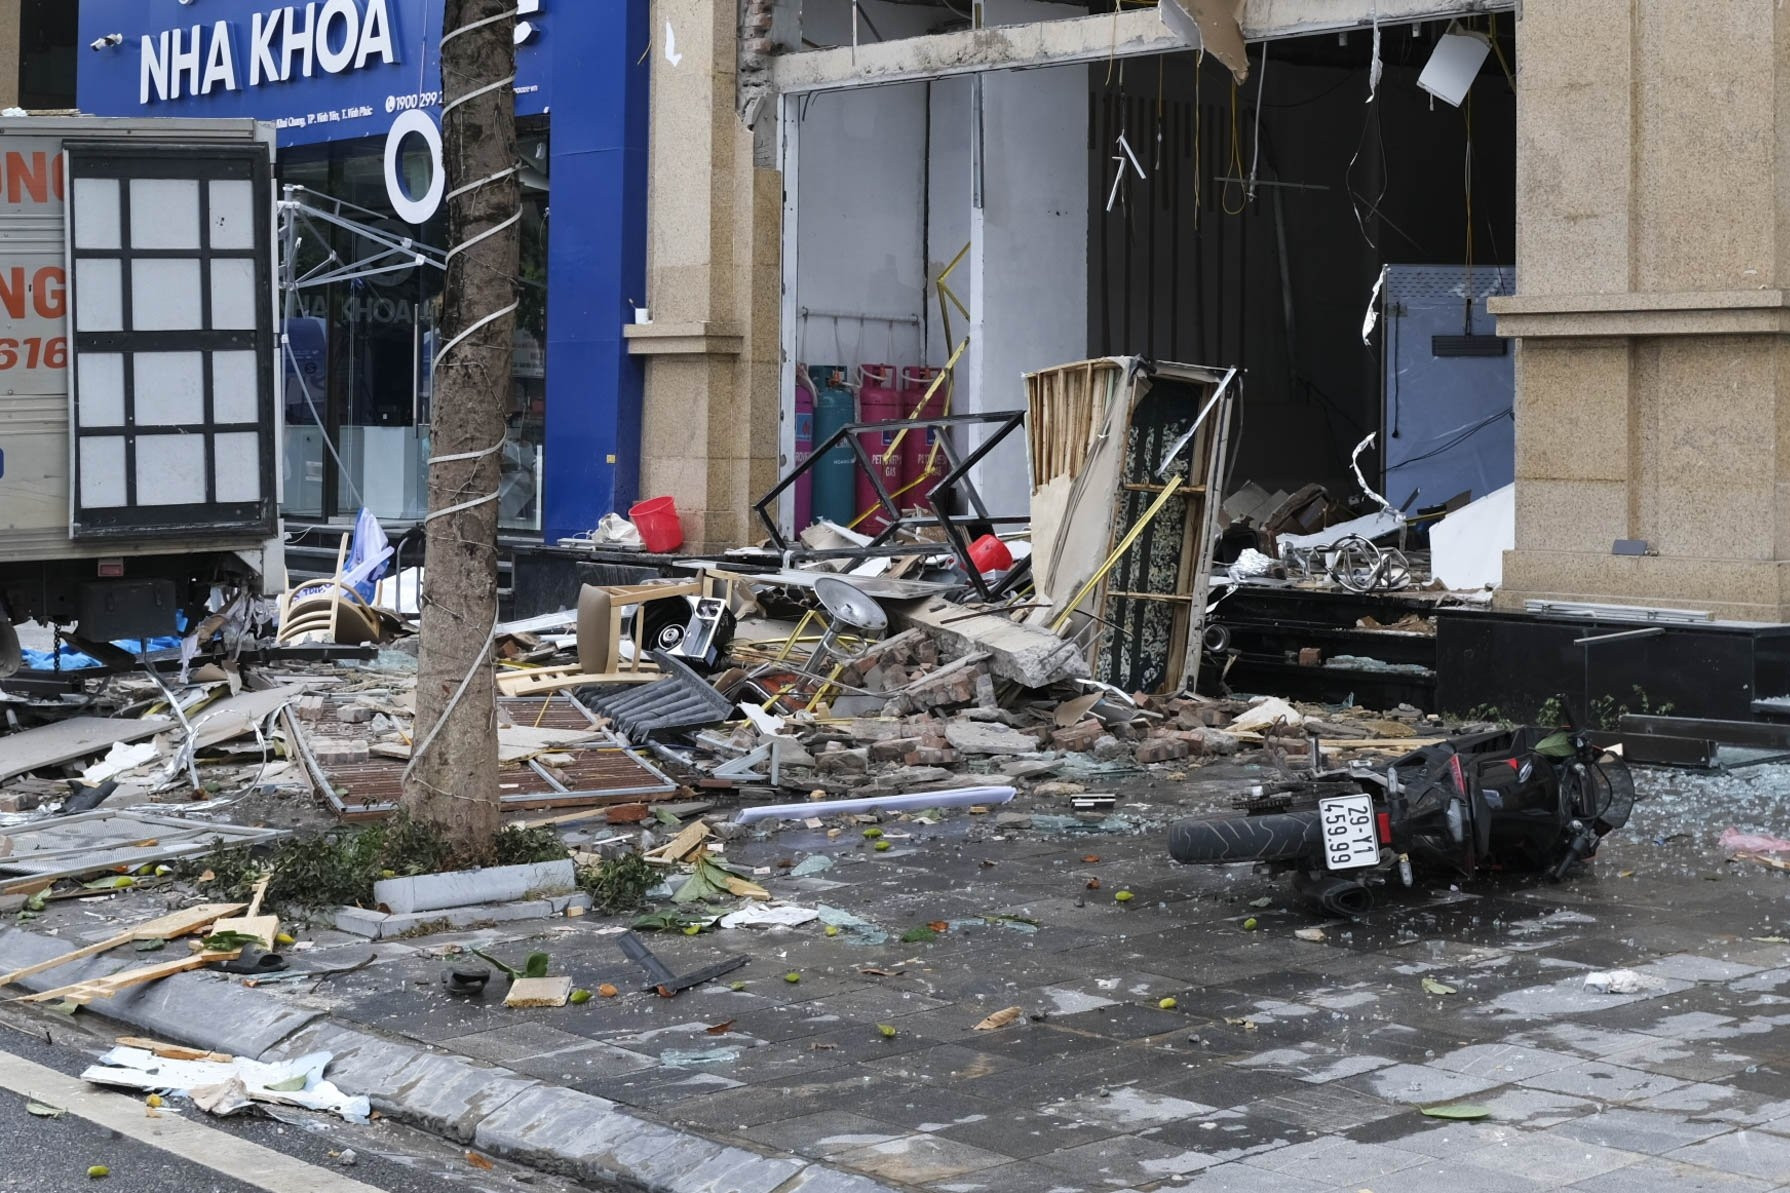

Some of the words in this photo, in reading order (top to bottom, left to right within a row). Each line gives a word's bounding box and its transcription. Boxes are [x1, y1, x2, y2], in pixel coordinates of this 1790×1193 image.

[140, 19, 238, 104] NHA
[249, 0, 396, 87] KHOA
[396, 94, 418, 110] 1900
[419, 91, 438, 108] 299
[1324, 804, 1351, 864] 459.99
[1348, 806, 1374, 854] 29-Y1
